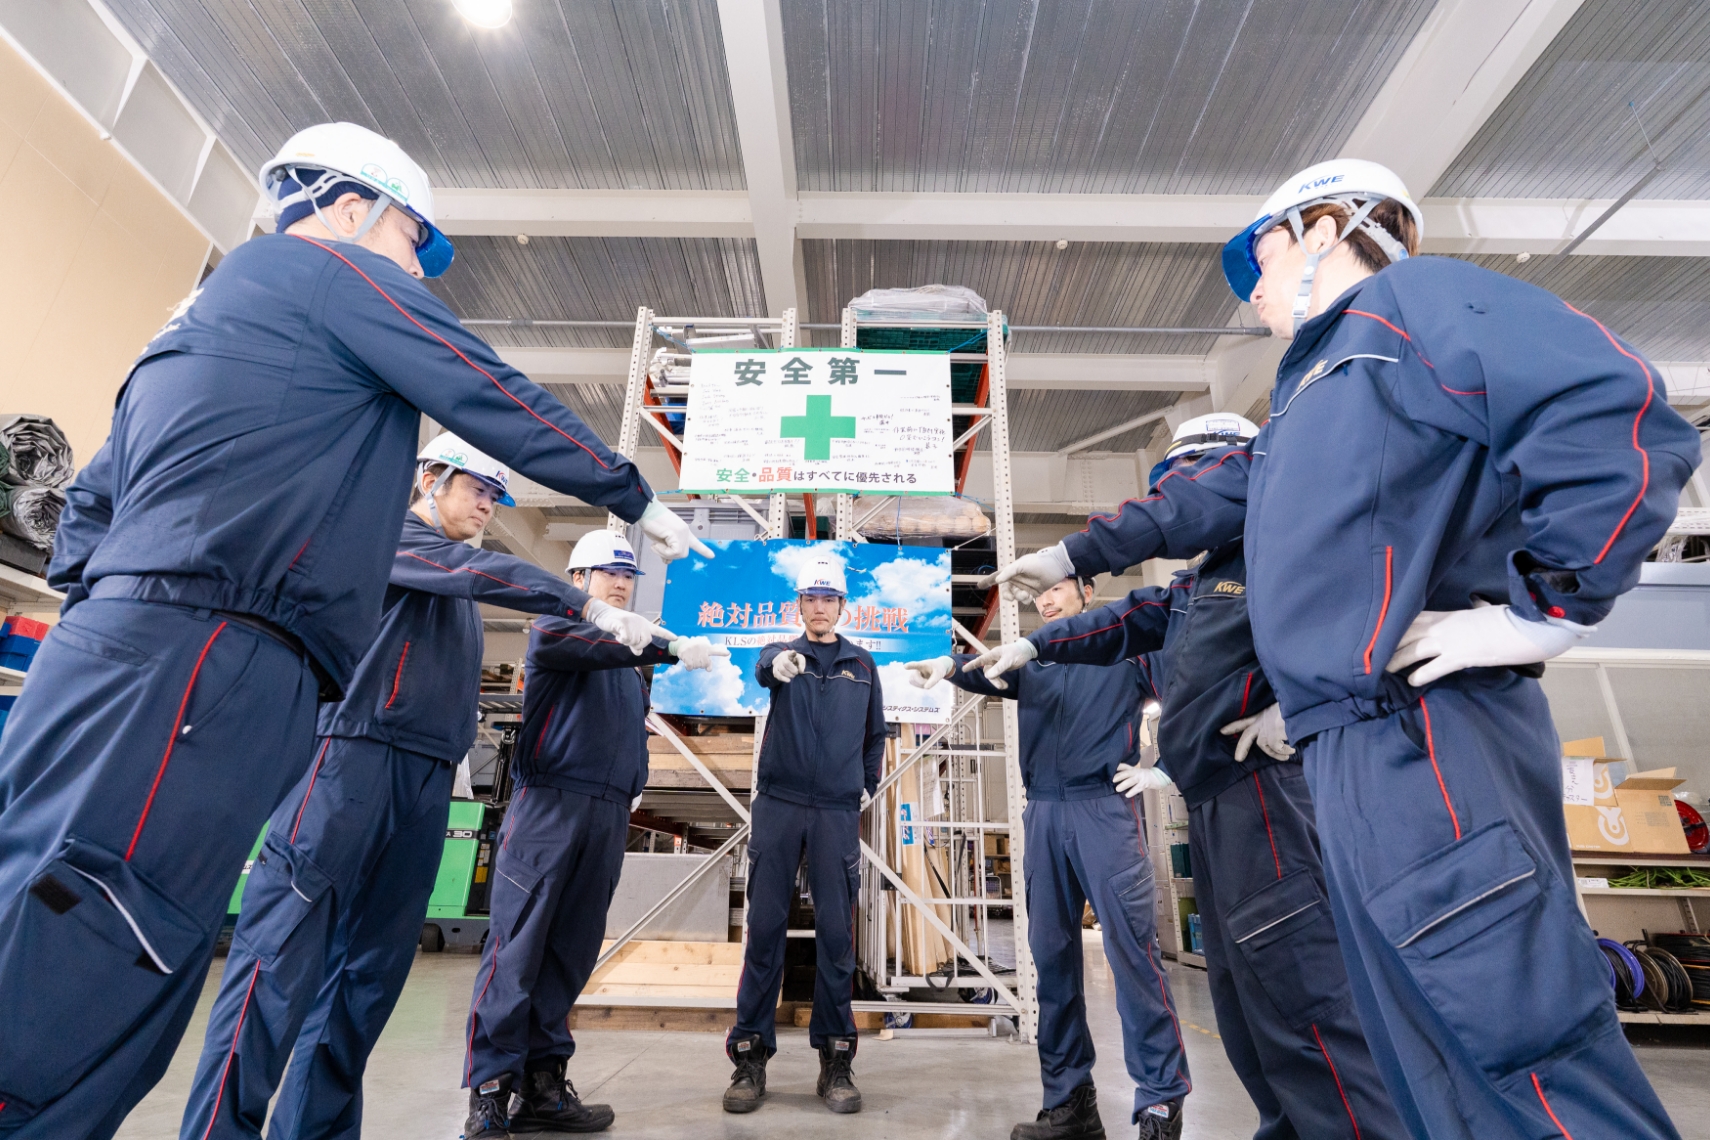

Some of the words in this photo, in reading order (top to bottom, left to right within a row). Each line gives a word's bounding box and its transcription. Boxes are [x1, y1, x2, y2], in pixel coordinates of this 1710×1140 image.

[1298, 175, 1345, 194] KWE
[734, 357, 907, 386] 安全第一
[716, 467, 917, 484] 安全・品質はすべてに優先される
[814, 578, 831, 586] KWE
[1213, 581, 1246, 595] KWE
